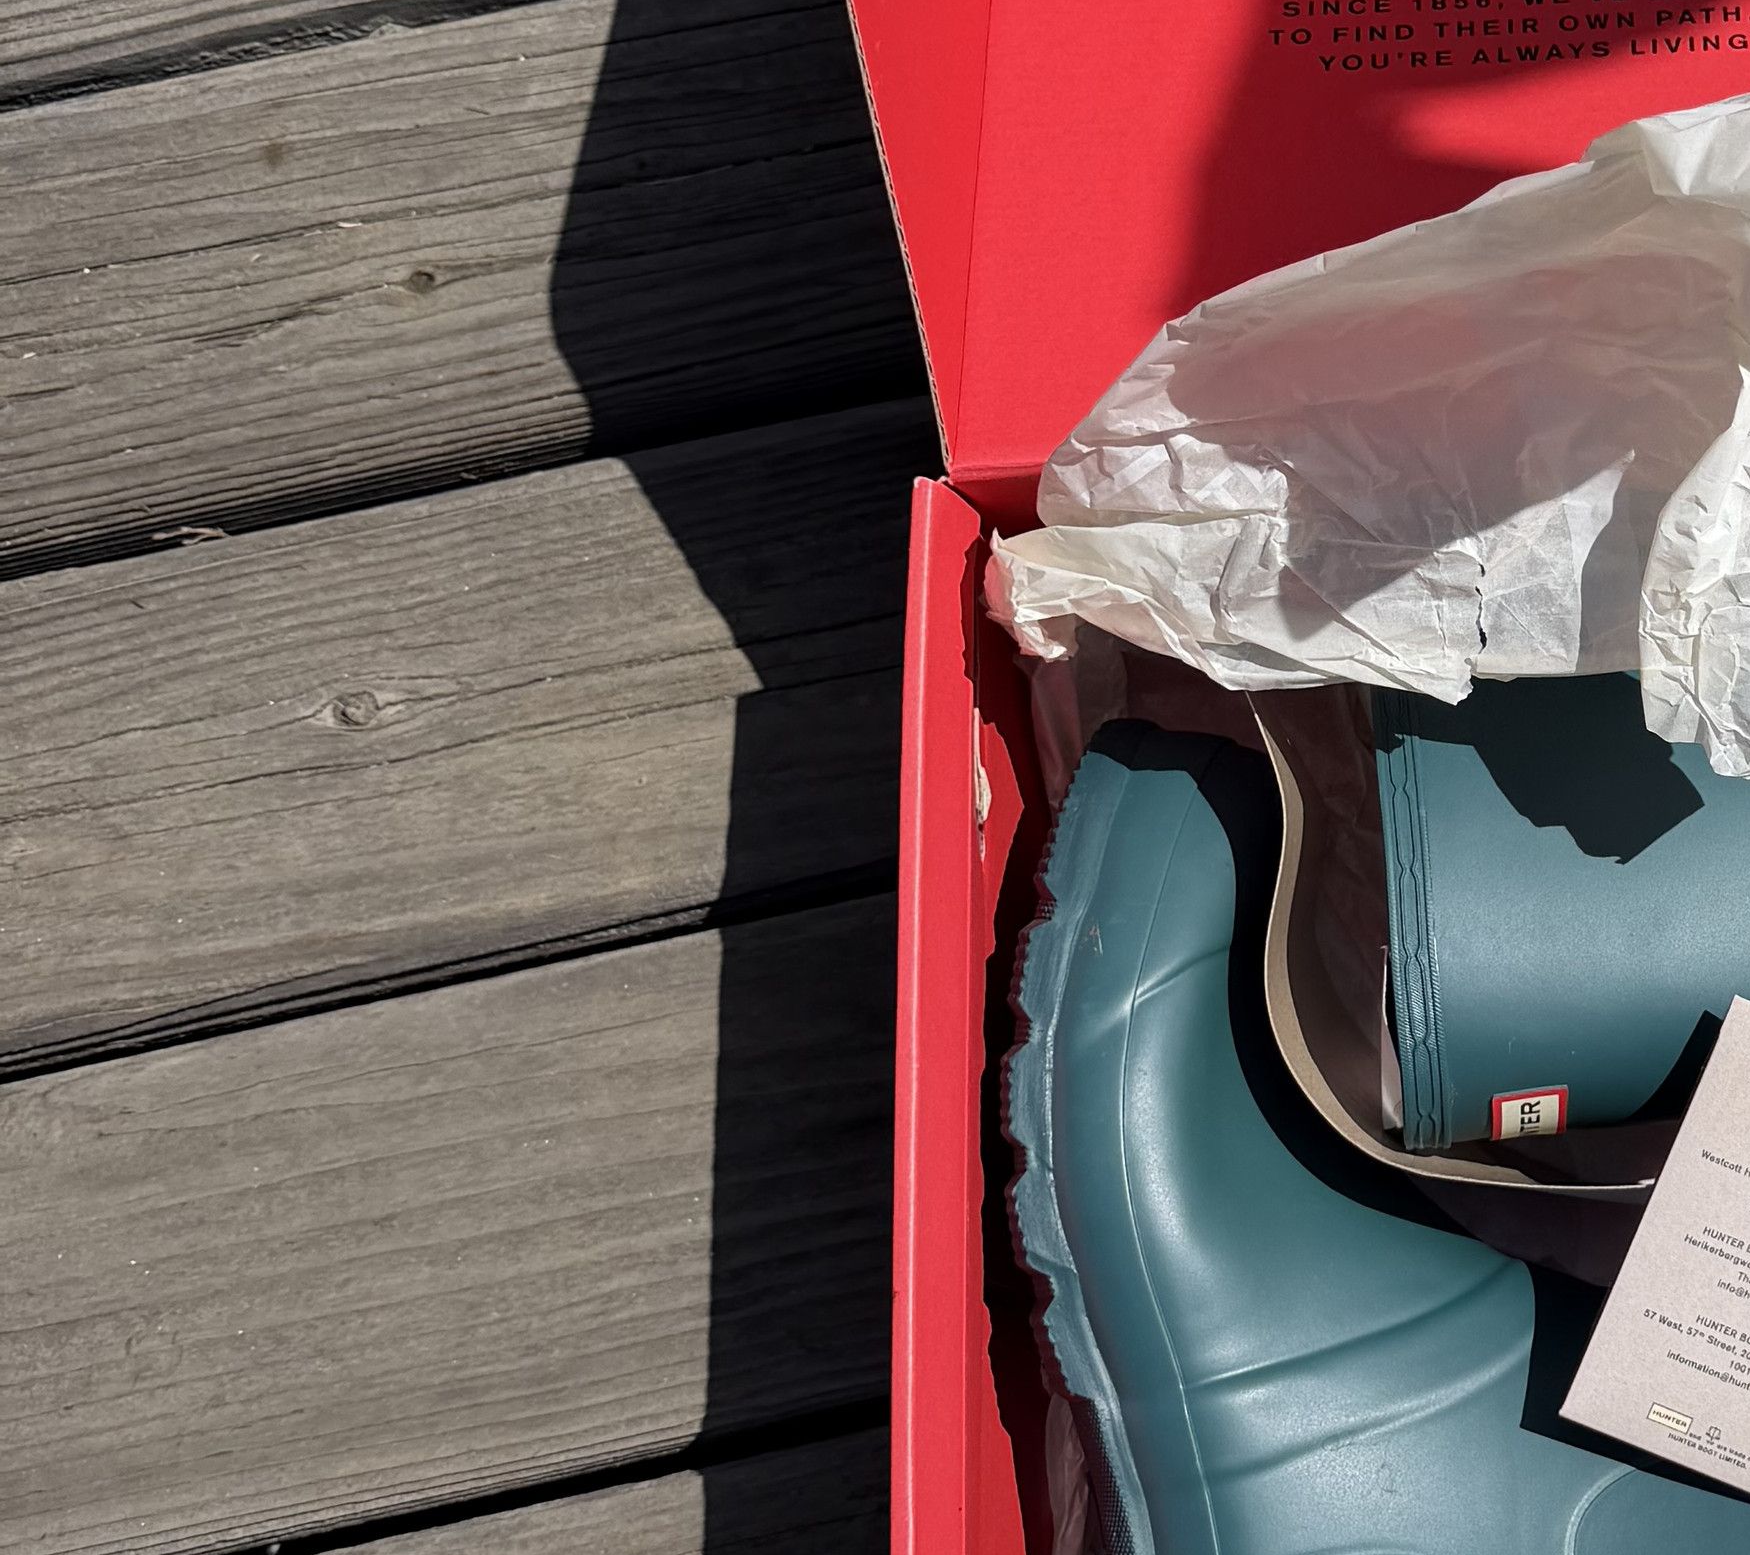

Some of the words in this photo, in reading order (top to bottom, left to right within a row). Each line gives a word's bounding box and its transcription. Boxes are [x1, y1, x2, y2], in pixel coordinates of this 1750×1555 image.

[1269, 28, 1312, 45] TO
[1333, 25, 1414, 43] FIND
[1435, 18, 1538, 39] THEIR
[1559, 12, 1635, 32] OWN
[1319, 51, 1451, 72] YOU'RE
[1472, 42, 1610, 65] ALWAYS
[1631, 34, 1749, 56] LIVING
[1701, 1148, 1743, 1174] Westcott
[1702, 1225, 1745, 1251] HUNTER
[1643, 1308, 1658, 1320] 57
[1658, 1314, 1684, 1334] West,
[1705, 1334, 1738, 1356] Street,
[1695, 1314, 1738, 1339] HUNTER
[1651, 1408, 1688, 1428] HUNTER
[1667, 1432, 1697, 1449] HUNTER
[1697, 1444, 1718, 1457] BOOT
